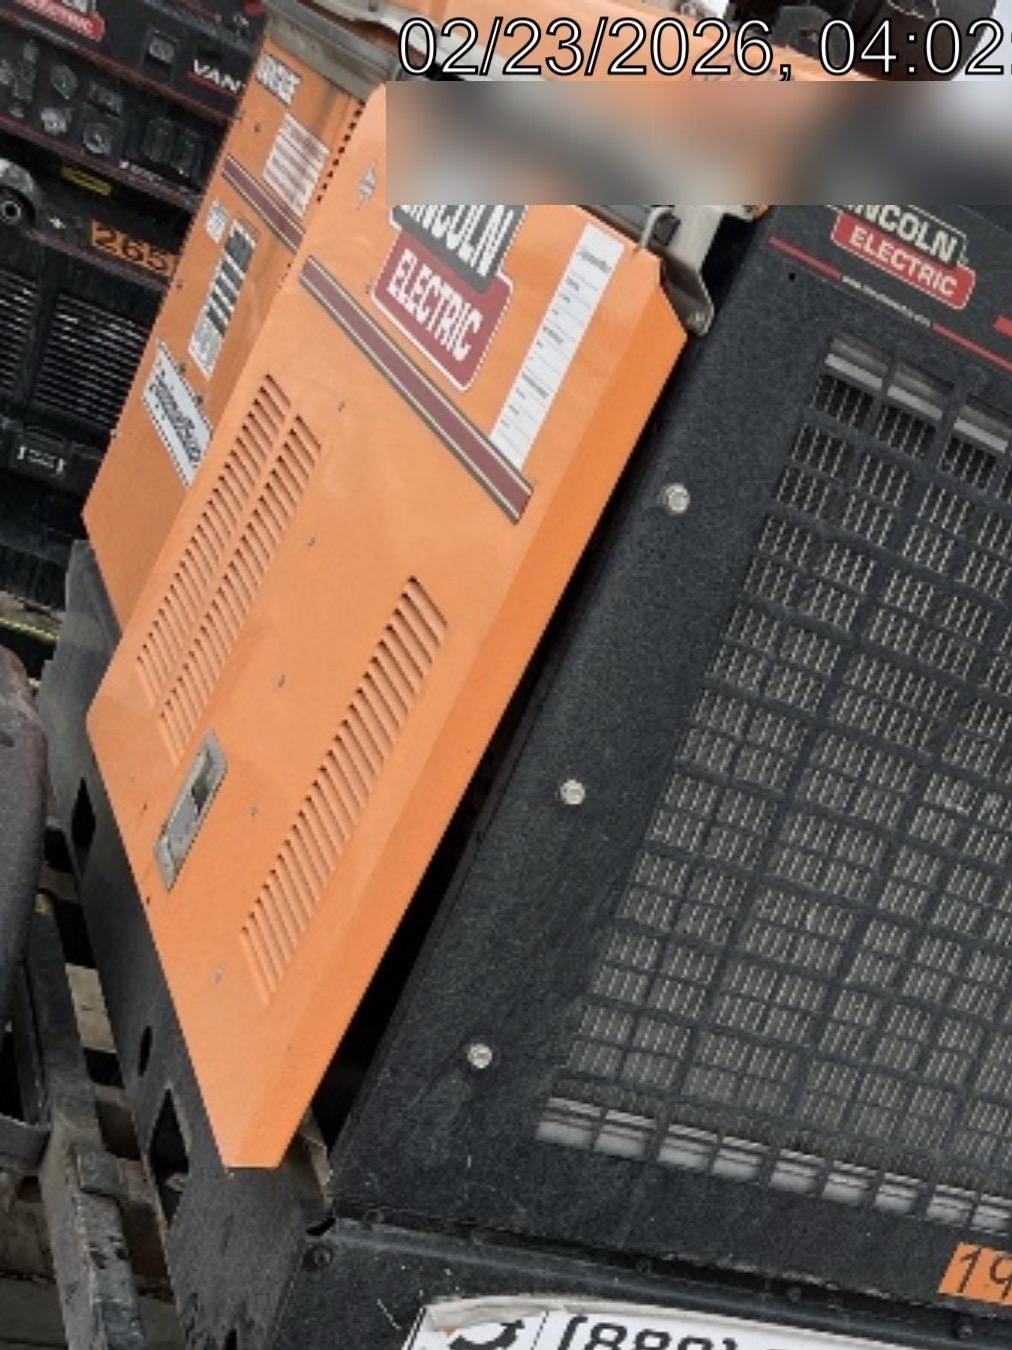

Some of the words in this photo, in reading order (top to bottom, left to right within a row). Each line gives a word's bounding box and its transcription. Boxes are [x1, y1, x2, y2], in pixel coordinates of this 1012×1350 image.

[192, 58, 245, 92] VAN
[849, 224, 958, 296] ELECTRIC
[386, 248, 484, 362] ELECTRIC
